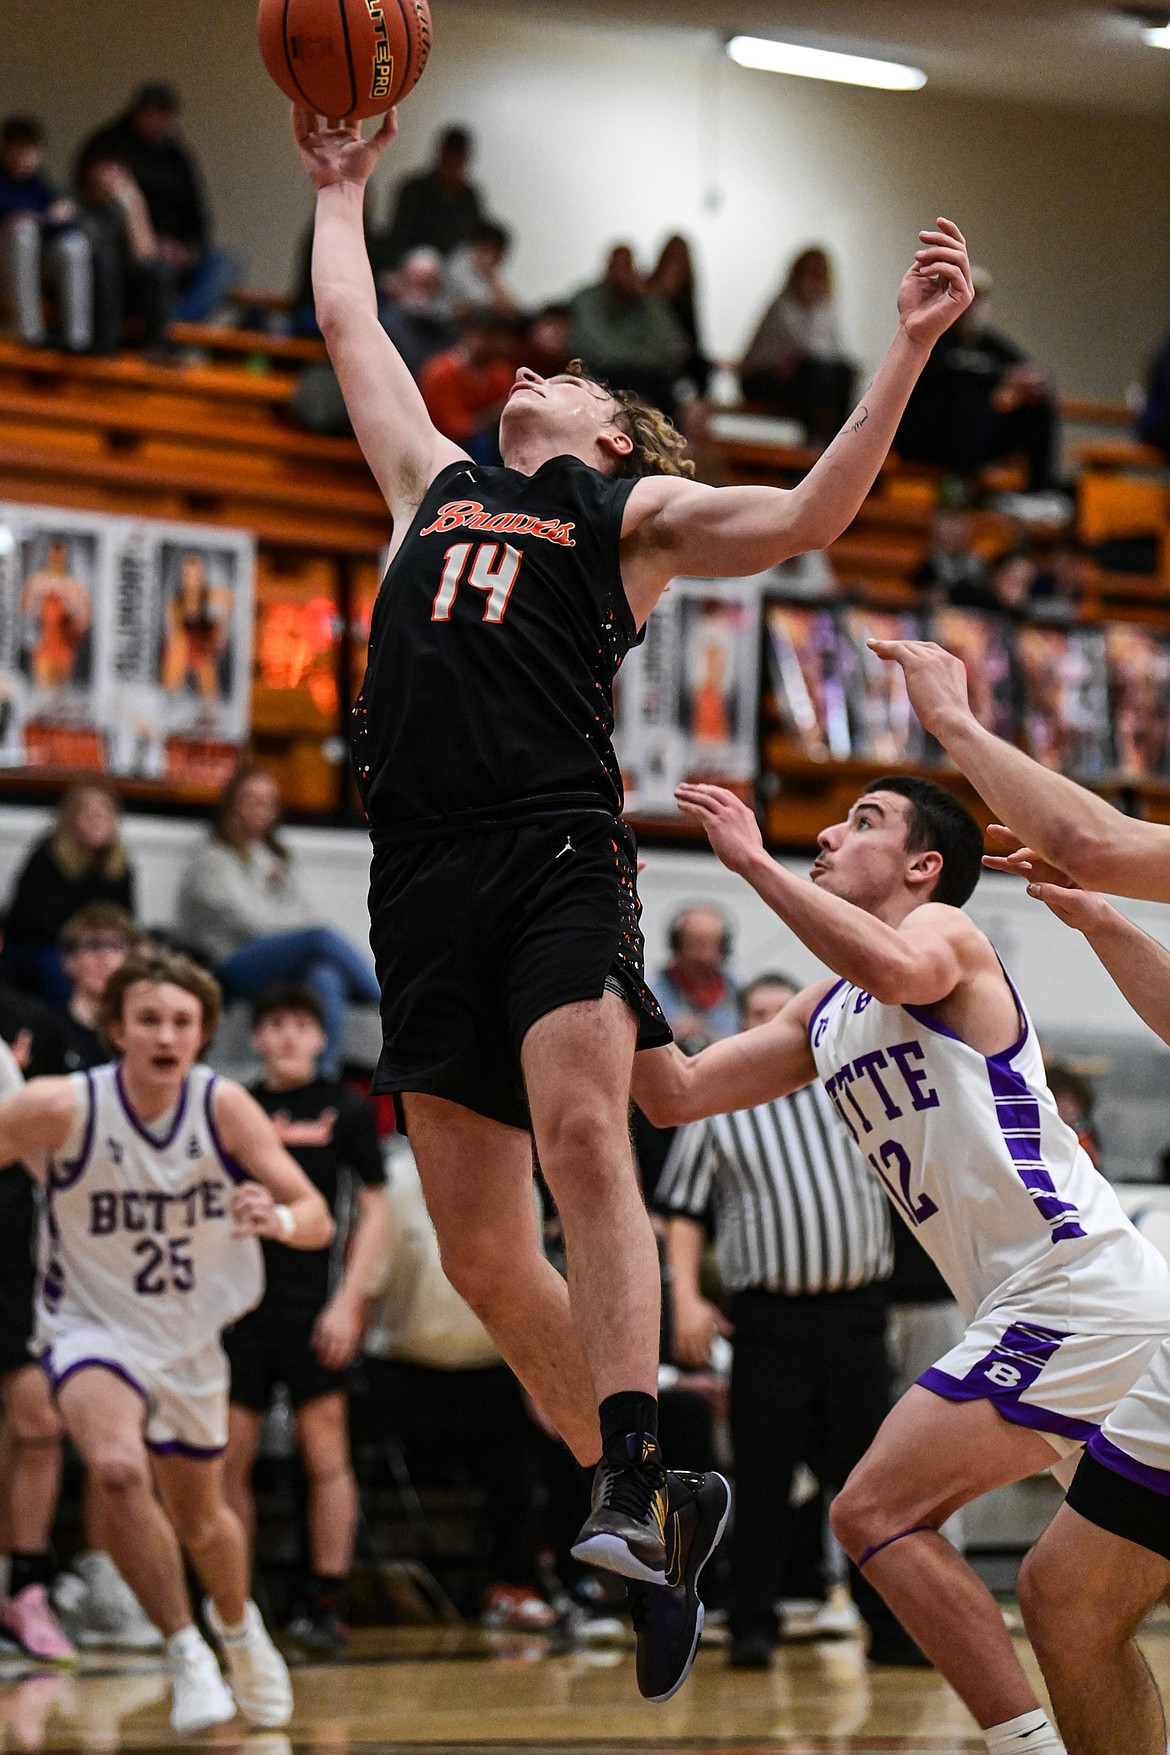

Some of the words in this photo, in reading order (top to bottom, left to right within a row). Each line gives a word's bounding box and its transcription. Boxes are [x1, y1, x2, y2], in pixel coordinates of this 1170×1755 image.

[373, 64, 391, 97] PRO
[420, 500, 576, 547] Braves
[431, 542, 524, 624] 14
[868, 1139, 939, 1227] 12
[134, 1236, 195, 1293] 25
[983, 1361, 1021, 1387] B
